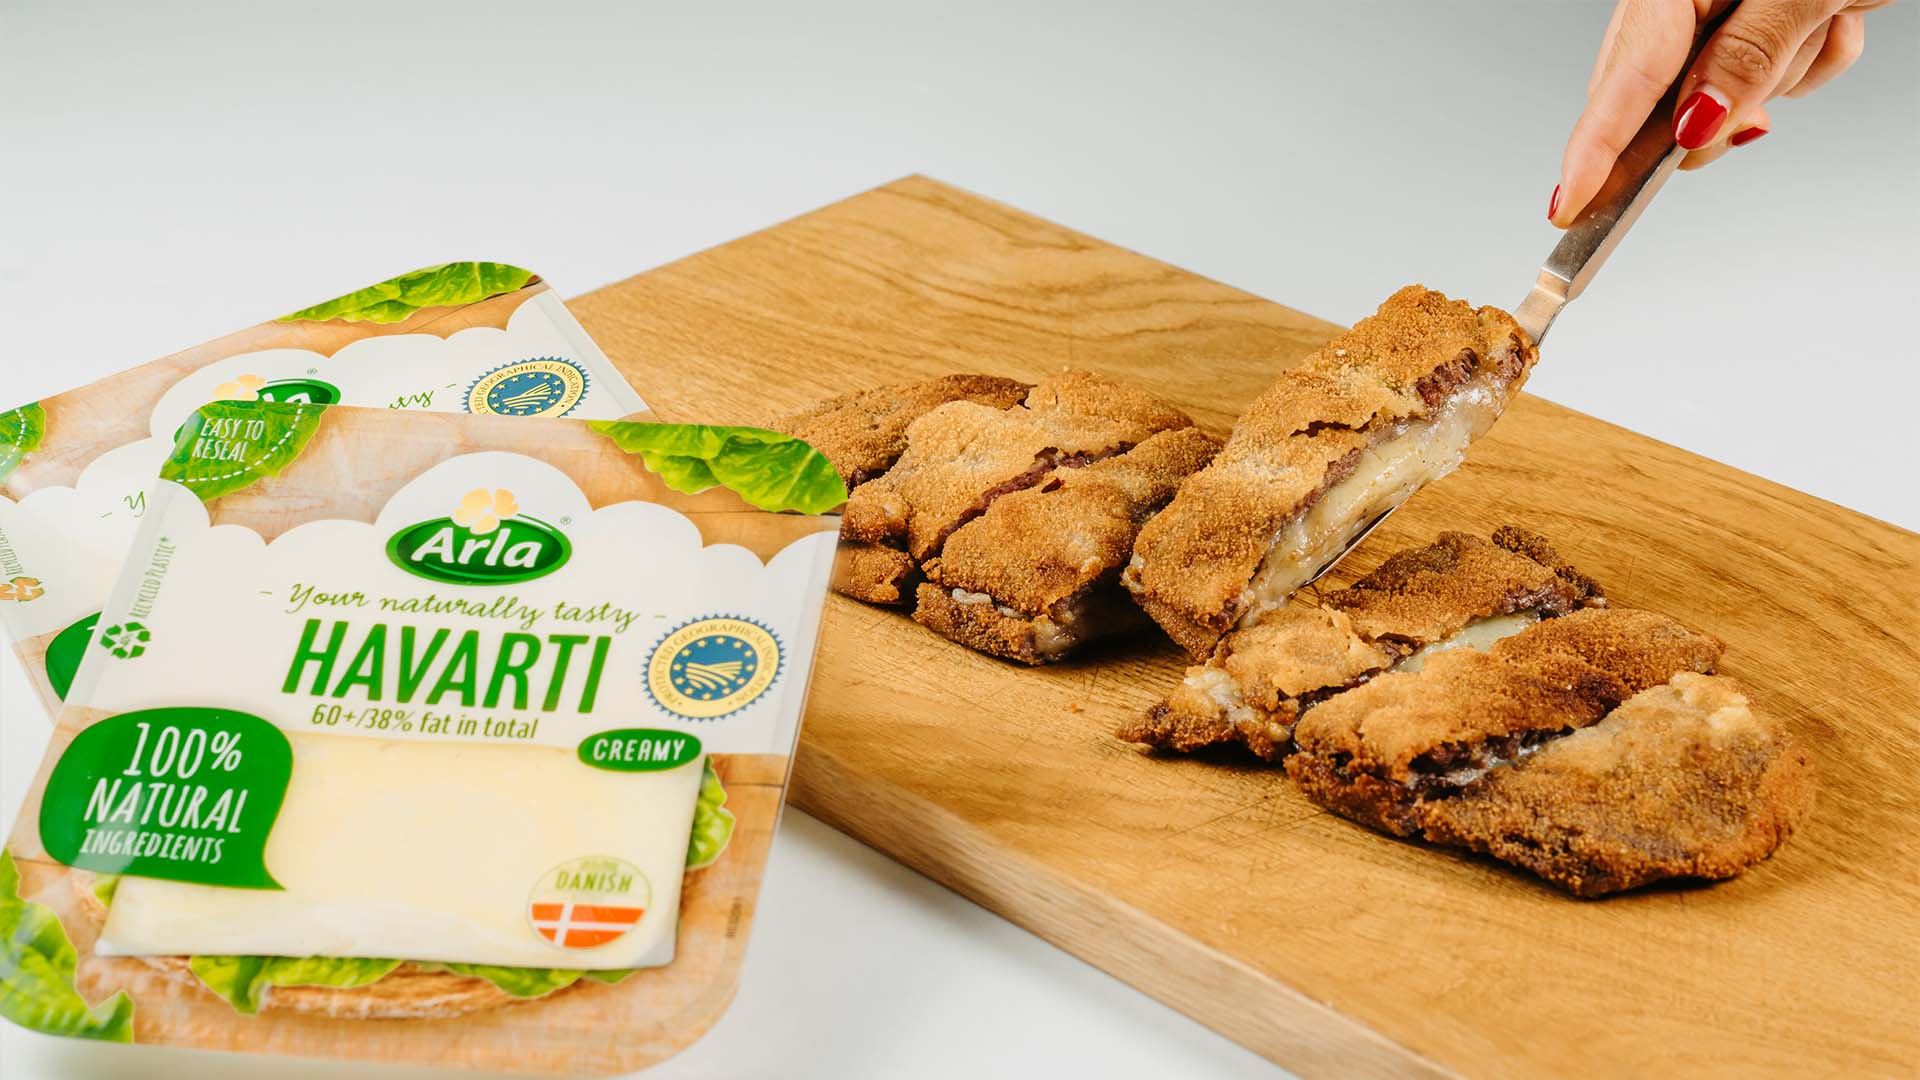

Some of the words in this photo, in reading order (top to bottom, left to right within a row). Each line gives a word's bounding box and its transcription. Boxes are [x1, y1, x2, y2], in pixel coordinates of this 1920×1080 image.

[200, 418, 243, 439] EASY
[244, 419, 265, 441] TO
[192, 437, 249, 463] RESEAL
[411, 527, 543, 568] Arla
[284, 583, 371, 614] Your
[378, 595, 545, 631] naturally
[554, 600, 640, 634] tasty
[282, 618, 613, 714] HAVARTI
[311, 703, 415, 732] 60+/38%
[419, 712, 451, 735] fat
[456, 714, 479, 736] in
[483, 717, 539, 739] total
[123, 722, 242, 779] 100%
[593, 738, 686, 762] CREAMY
[83, 777, 249, 833] NATURAL
[80, 828, 225, 864] INGREDIENTS
[555, 871, 633, 893] DANISH
